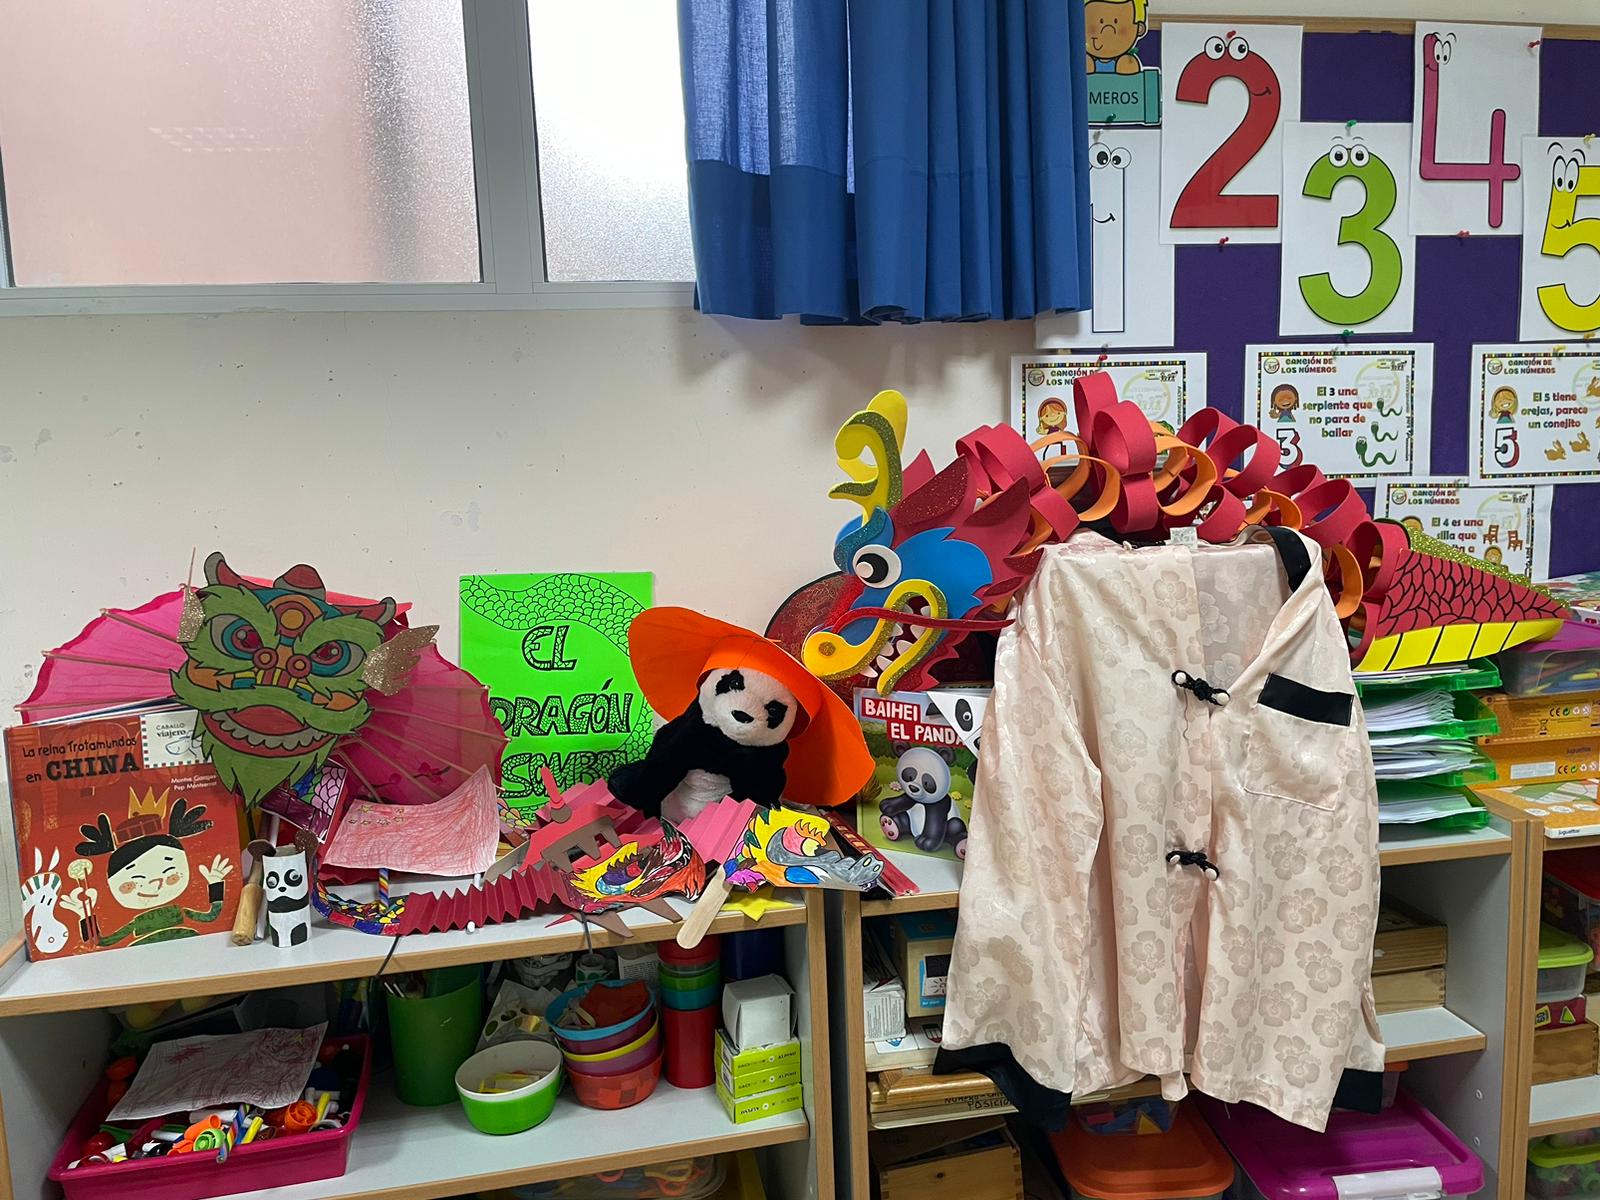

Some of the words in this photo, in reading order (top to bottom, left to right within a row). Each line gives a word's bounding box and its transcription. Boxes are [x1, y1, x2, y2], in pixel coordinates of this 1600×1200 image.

[1089, 91, 1139, 105] MEROS
[1419, 33, 1521, 229] 4
[1169, 48, 1281, 229] 2
[1298, 147, 1403, 326] 3
[1536, 165, 1600, 333] 5
[1285, 356, 1321, 365] CANCIÓN
[1508, 358, 1541, 367] CANCIÓN
[1050, 367, 1087, 377] CANCIÓN
[1281, 366, 1297, 374] LOS
[1298, 365, 1337, 374] NÚMEROS
[1520, 366, 1556, 375] NÚMEROS
[1046, 379, 1063, 387] LOS
[1317, 386, 1326, 397] El
[1329, 387, 1335, 397] 3
[1337, 388, 1358, 397] una
[1533, 392, 1542, 402] El
[1544, 393, 1550, 402] 5
[1552, 392, 1577, 401] tiene
[1302, 400, 1350, 412] serpiente
[1352, 402, 1373, 412] que
[1521, 406, 1553, 416] orejas,
[1556, 406, 1588, 416] parece
[1309, 415, 1322, 425] no
[1325, 415, 1350, 426] para
[1352, 414, 1366, 423] de
[1528, 421, 1540, 429] un
[1543, 418, 1581, 429] conejito
[1321, 428, 1354, 438] bailar
[1276, 428, 1303, 469] 3
[1494, 427, 1520, 468] 5
[1412, 488, 1446, 497] CANCIÓN
[1424, 497, 1460, 505] NÚMEROS
[1432, 517, 1440, 527] El
[1442, 518, 1449, 527] 4
[1452, 519, 1461, 527] es
[1463, 519, 1483, 527] una
[1436, 531, 1455, 540] silla
[1458, 532, 1477, 541] que
[522, 625, 577, 671] EL
[490, 678, 634, 736] DRAGÓN
[865, 698, 918, 722] BAIHEI
[156, 722, 186, 731] CABALLO
[890, 722, 910, 740] EL
[156, 728, 187, 738] viajero
[22, 747, 36, 758] La
[26, 771, 42, 784] en
[46, 752, 140, 781] CHINA
[501, 751, 627, 798] SOMBR
